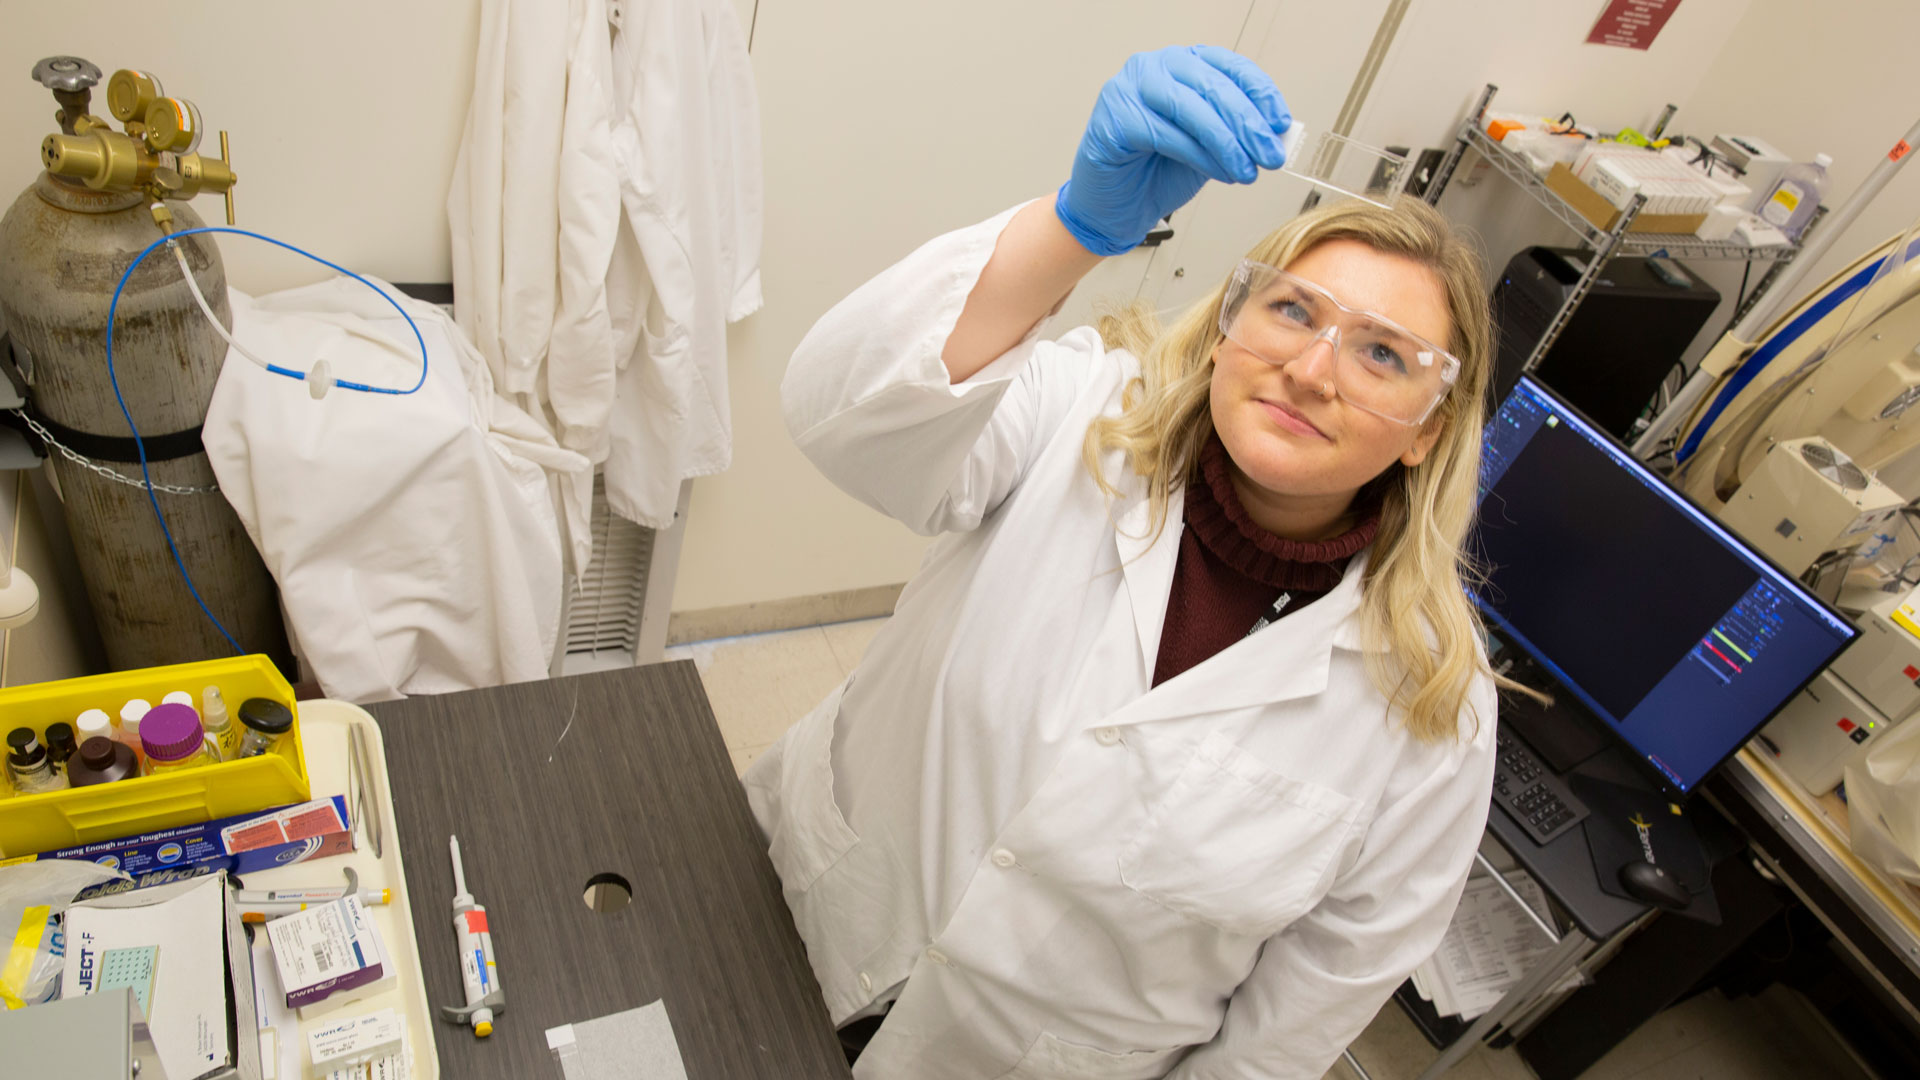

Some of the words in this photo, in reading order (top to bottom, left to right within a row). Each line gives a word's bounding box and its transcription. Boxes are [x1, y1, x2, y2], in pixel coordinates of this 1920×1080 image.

[56, 846, 84, 859] Strong
[86, 841, 116, 854] Enough
[126, 838, 139, 847] your
[140, 830, 175, 843] Toughest
[176, 825, 205, 836] situations!
[185, 837, 203, 845] Cover
[140, 864, 210, 888] Wrap
[348, 898, 358, 917] VWR
[289, 986, 315, 999] VWR
[314, 1029, 336, 1039] VWR
